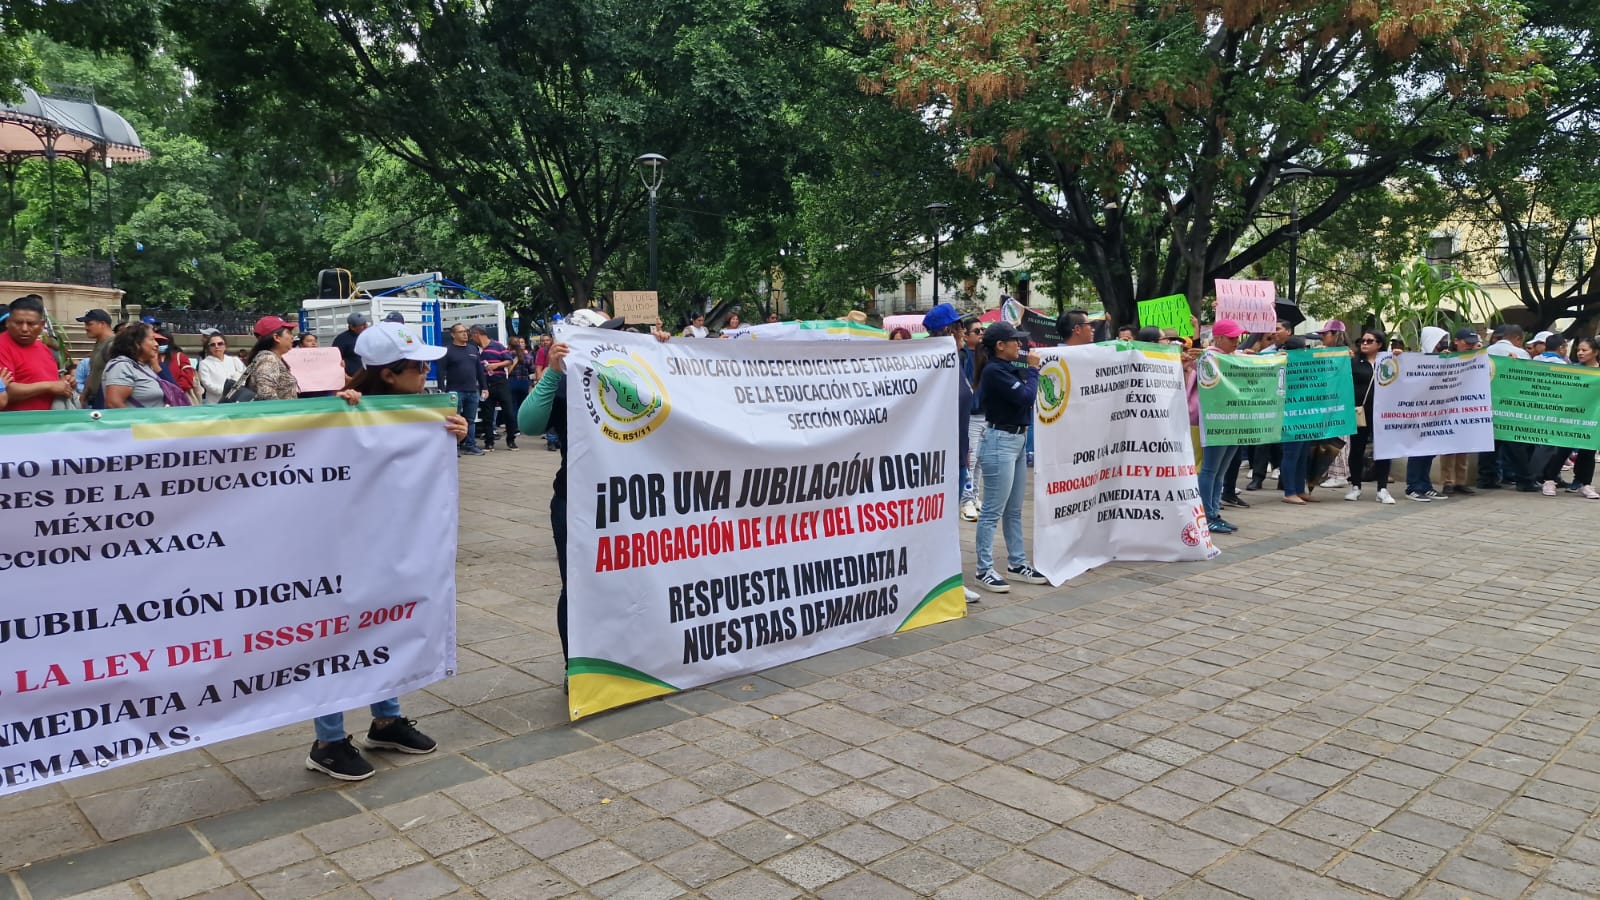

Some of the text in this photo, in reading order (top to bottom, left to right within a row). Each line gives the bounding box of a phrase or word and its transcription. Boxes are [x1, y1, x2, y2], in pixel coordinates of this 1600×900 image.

[590, 344, 628, 358] OAXACA
[666, 351, 956, 378] SINDICATO INDEPENDIENTE DE TRABAJADORES
[1039, 355, 1059, 371] AXACA
[734, 375, 918, 404] DE LA EDUCACIÓN DE MÉXICO
[1130, 378, 1144, 388] DE
[1460, 393, 1486, 403] DIGNA!
[787, 407, 889, 430] SECCIÓN OAXACA
[1460, 416, 1491, 425] NUESTR
[51, 446, 258, 476] INDEPEDIENTE
[264, 442, 297, 460] DE
[1073, 450, 1095, 465] ¡POR
[65, 486, 105, 505] DE
[114, 482, 151, 501] LA
[160, 463, 313, 496] EDUCACIÓN
[321, 465, 352, 482] DE
[1099, 467, 1110, 481] DE
[1112, 465, 1123, 479] LA
[1126, 465, 1153, 477] LEY
[1155, 466, 1177, 478] DEL
[595, 449, 946, 529] ¡POR UNA JUBILACIÓN DIGNA!
[1098, 488, 1161, 503] INMEDIATA
[1165, 490, 1174, 501] A
[34, 511, 155, 537] MÉXICO
[1097, 508, 1164, 523] DEMANDAS.
[101, 531, 226, 559] OAXACA
[595, 492, 945, 573] ABROGACIÓN DE LA LEY DEL ISSSTE 2007
[668, 546, 908, 623] RESPUESTA INMEDIATA A
[0, 574, 343, 643] JUBILACIÓN DIGNA!
[683, 583, 899, 665] NUESTRAS DEMANDAS
[15, 601, 417, 693] LA LEY DEL ISSSTE 2007
[197, 684, 222, 706] A
[232, 646, 391, 698] NUESTRAS
[0, 725, 201, 788] EMANDAS.
